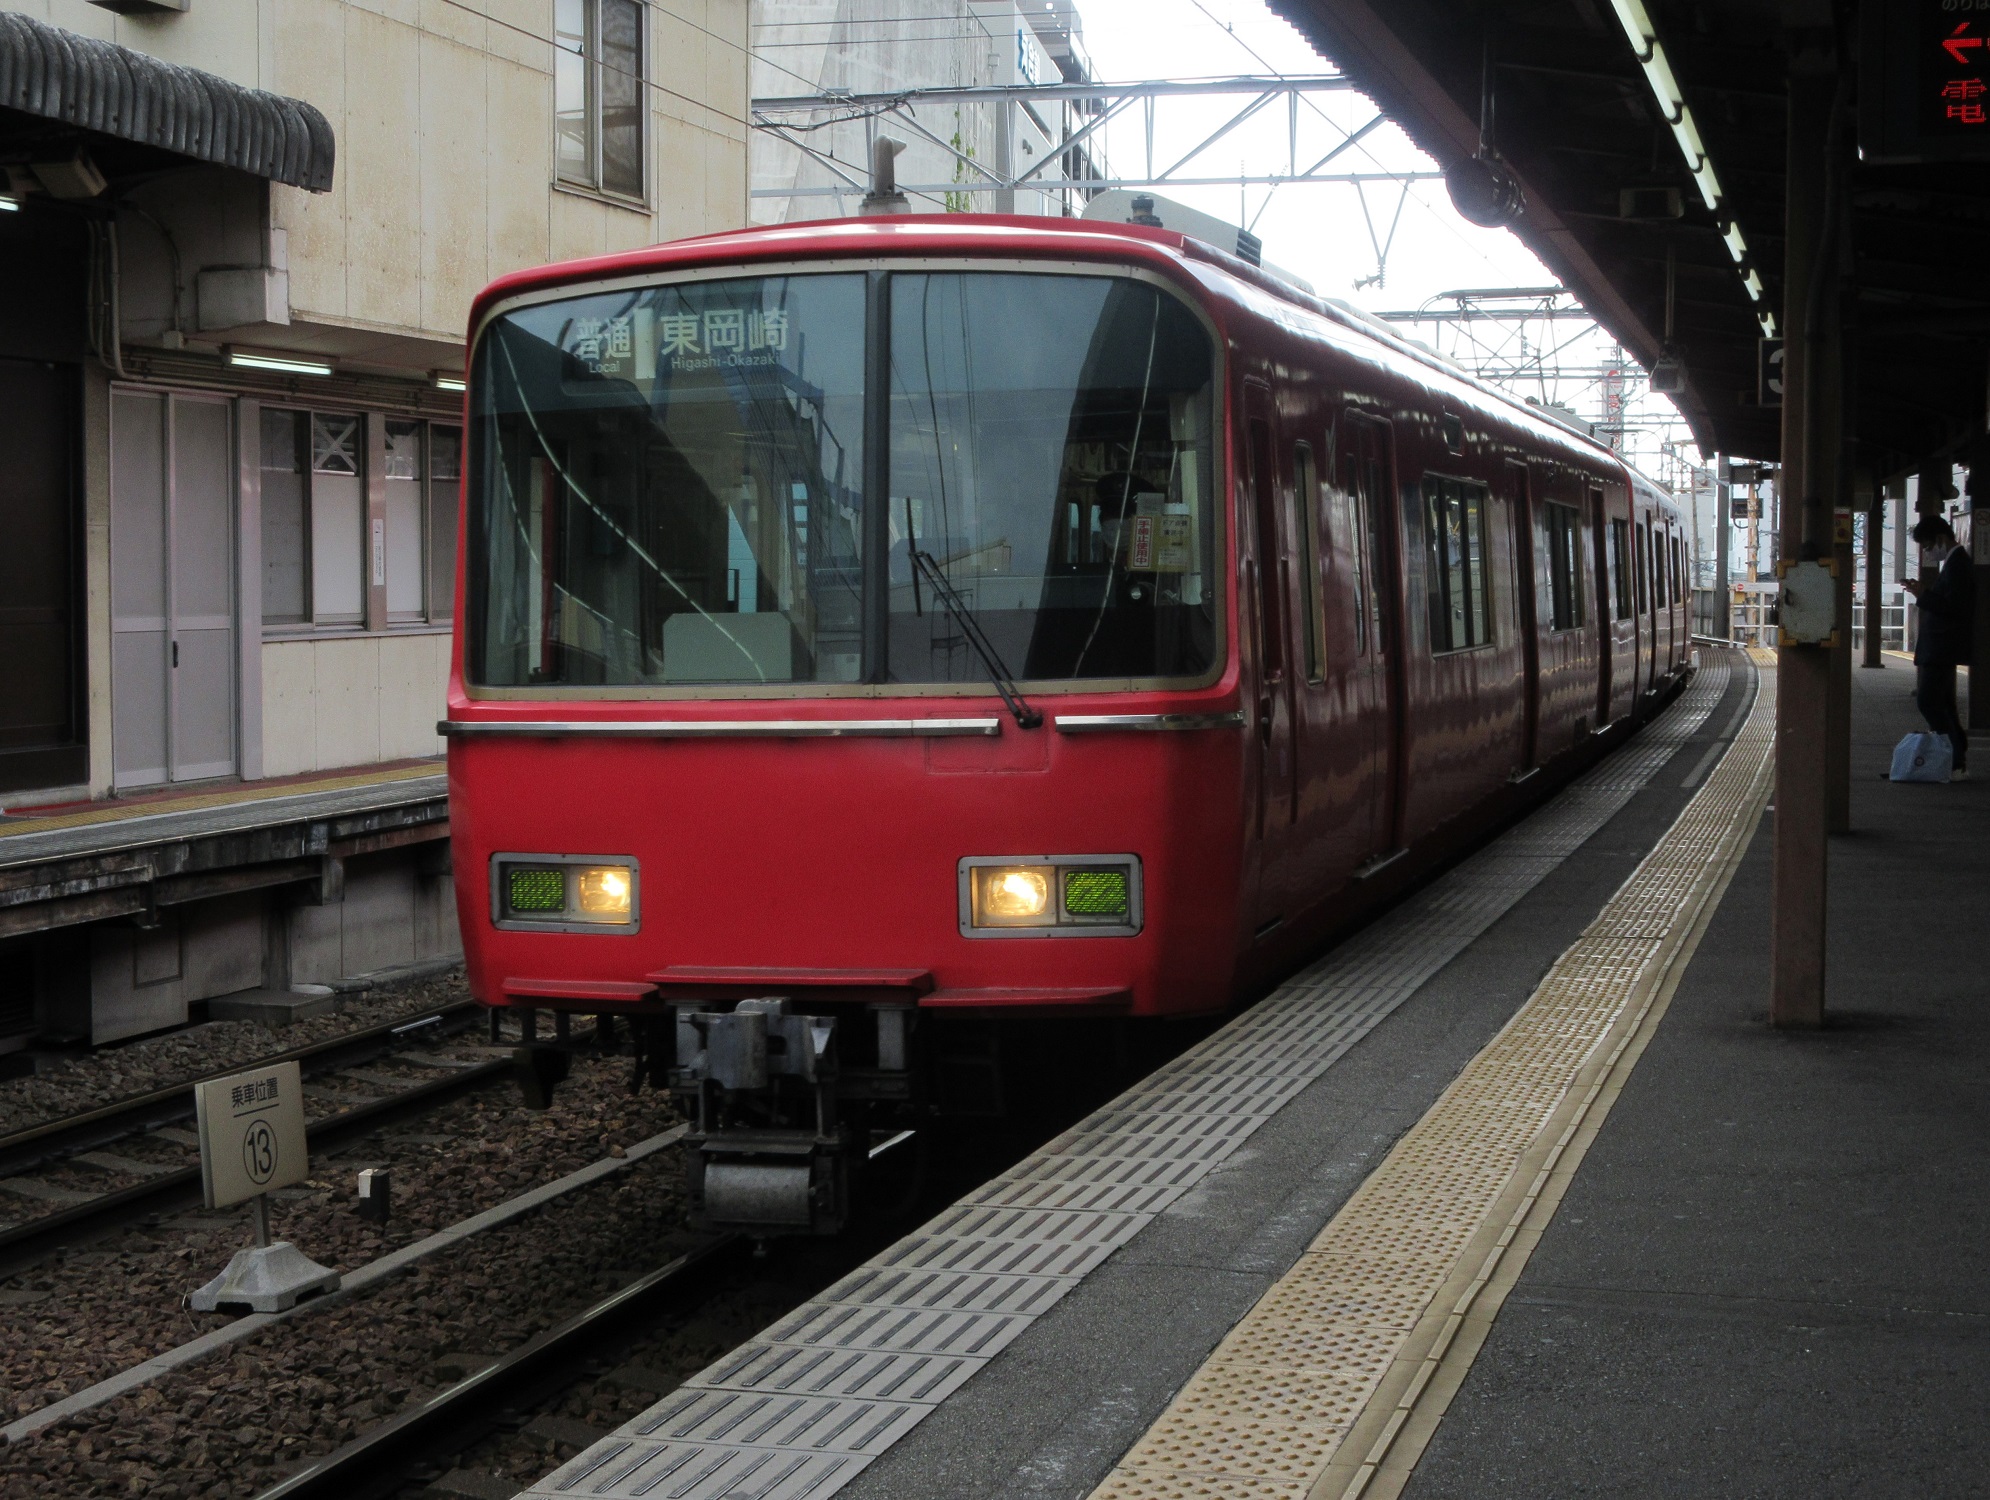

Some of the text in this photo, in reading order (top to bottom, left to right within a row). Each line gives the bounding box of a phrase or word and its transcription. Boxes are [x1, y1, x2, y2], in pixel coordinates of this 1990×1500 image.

[1941, 78, 1988, 123] 電
[576, 316, 631, 360] 普通
[660, 307, 788, 356] 東岡崎
[588, 360, 621, 373] Local
[671, 353, 781, 371] Higashi-Okazaki
[231, 1077, 279, 1108] 乗車位置
[247, 1128, 272, 1176] 13
